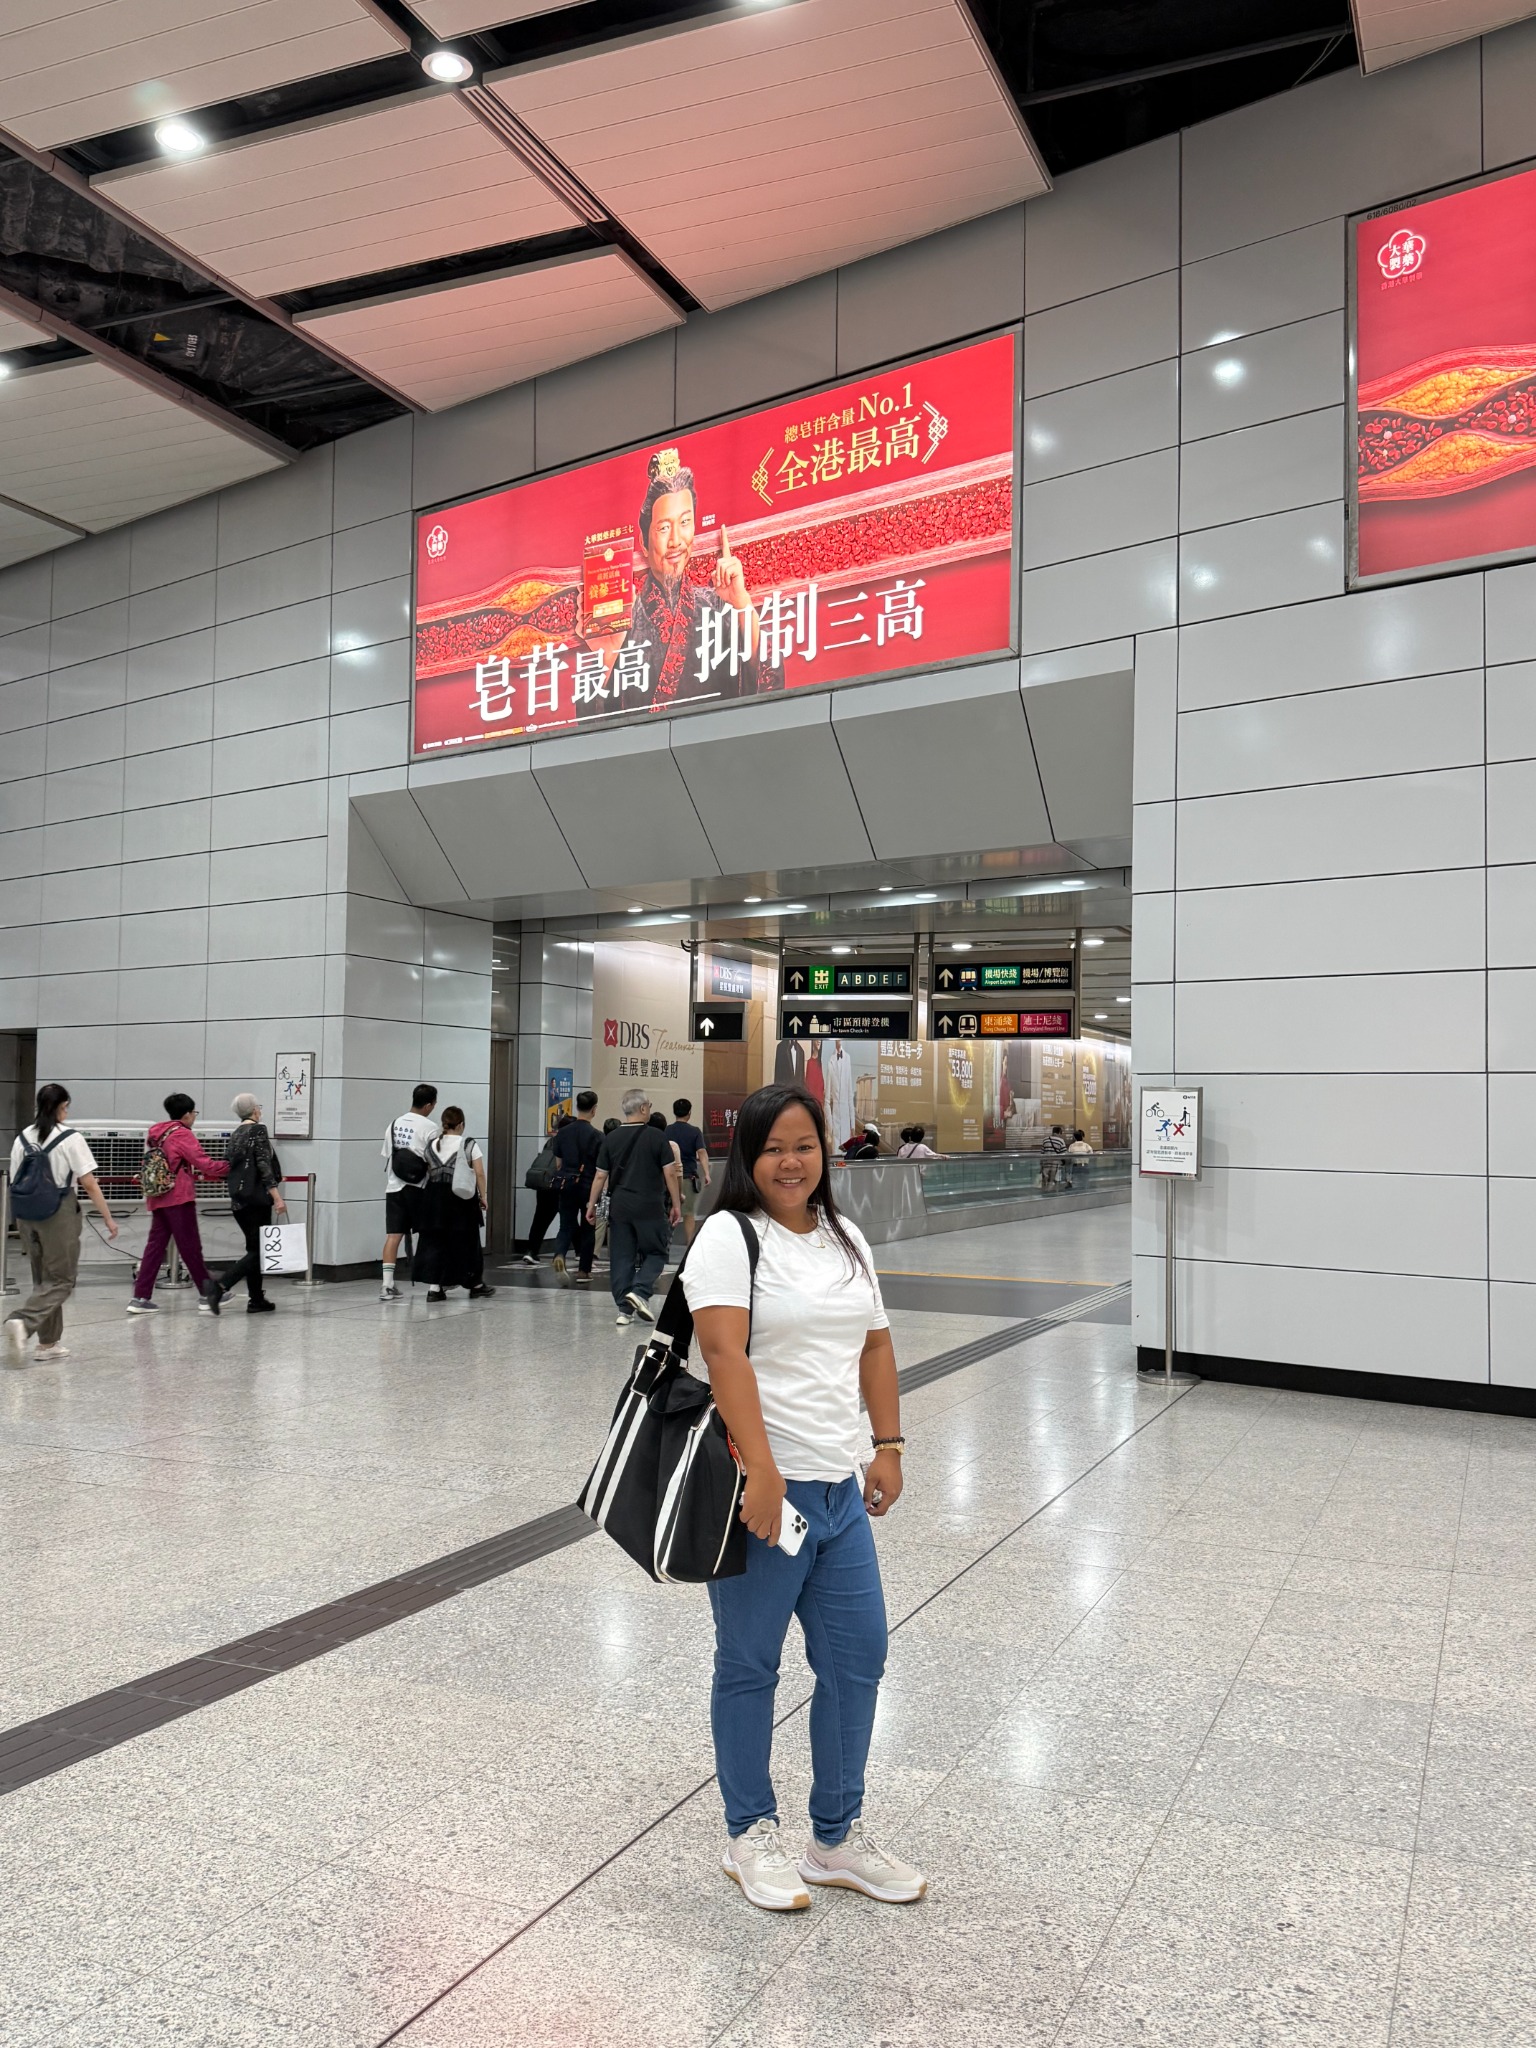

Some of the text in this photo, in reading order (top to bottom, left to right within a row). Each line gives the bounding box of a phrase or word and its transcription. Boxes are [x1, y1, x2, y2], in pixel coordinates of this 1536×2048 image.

[784, 382, 914, 444] 總皂苷含量 No.1
[775, 416, 922, 495] 全港最高
[469, 639, 652, 722] 皂苷最高
[694, 578, 926, 683] 抑制三高
[719, 966, 732, 980] DBS
[841, 974, 903, 985] A B D E F
[619, 1021, 695, 1057] DBS Treasures
[833, 1016, 890, 1028] 市區預辦登機
[618, 1057, 679, 1079] 星展豐盛理財
[264, 1226, 283, 1271] M&S
